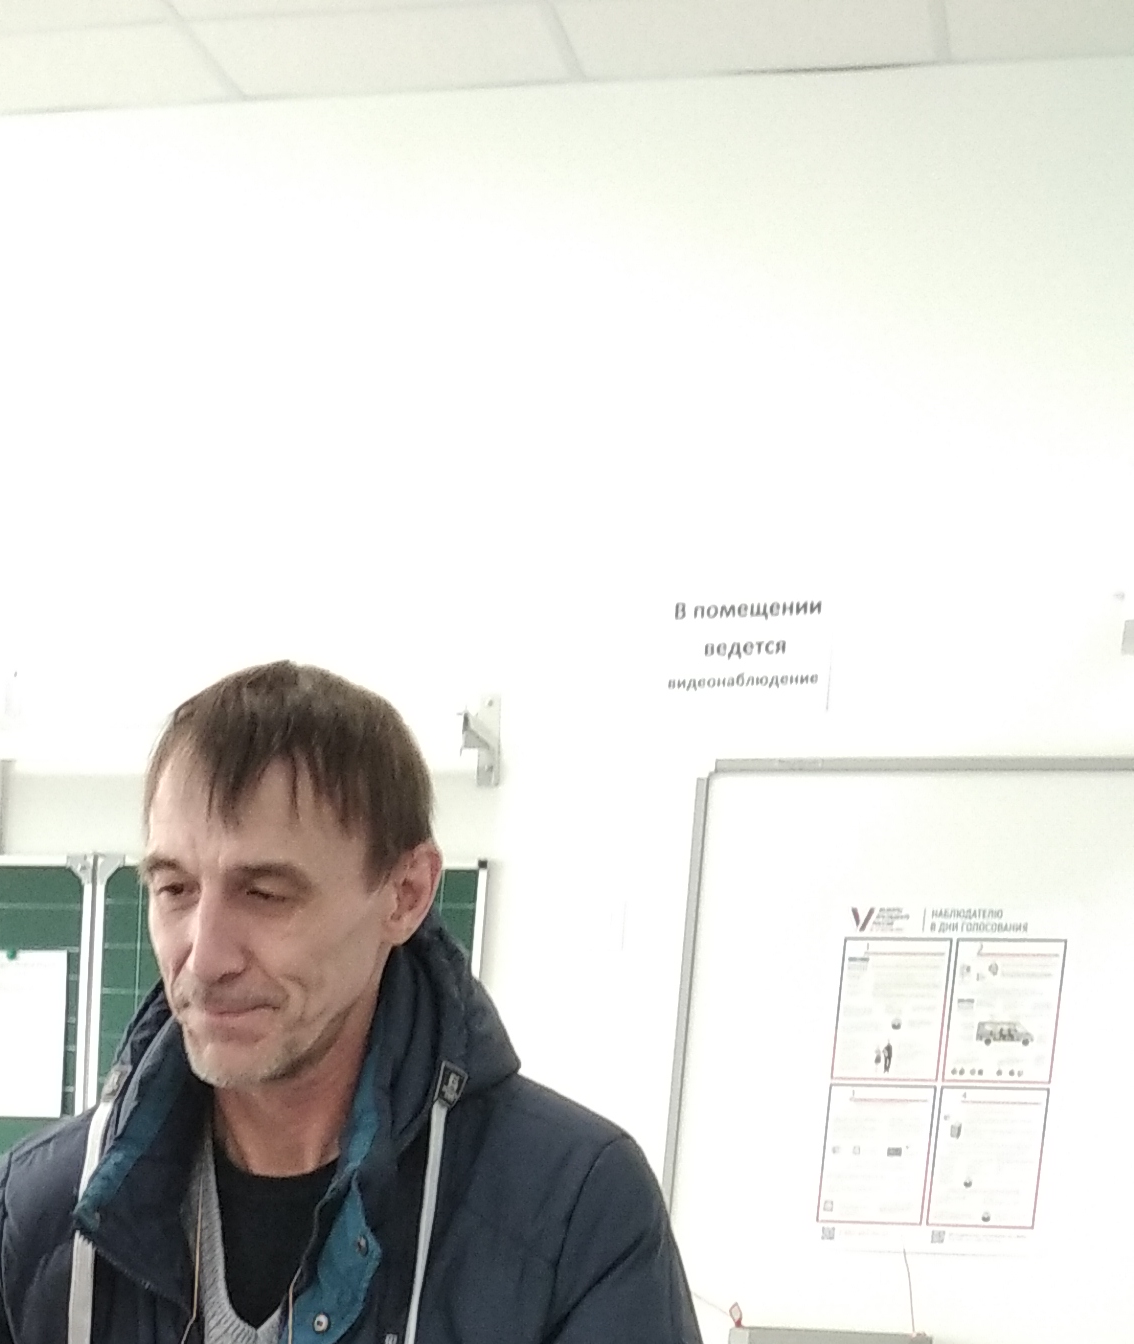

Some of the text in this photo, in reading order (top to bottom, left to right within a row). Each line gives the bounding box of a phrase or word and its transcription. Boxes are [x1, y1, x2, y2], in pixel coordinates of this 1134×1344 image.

[674, 600, 822, 620] В помещении
[704, 639, 787, 660] ведется
[668, 672, 819, 692] видеонаблюдение
[931, 908, 1003, 920] НАБЛЮДАТЕЛЮ
[938, 922, 959, 933] ДНИ
[960, 921, 1029, 933] ГОЛОСОВАНИЯ
